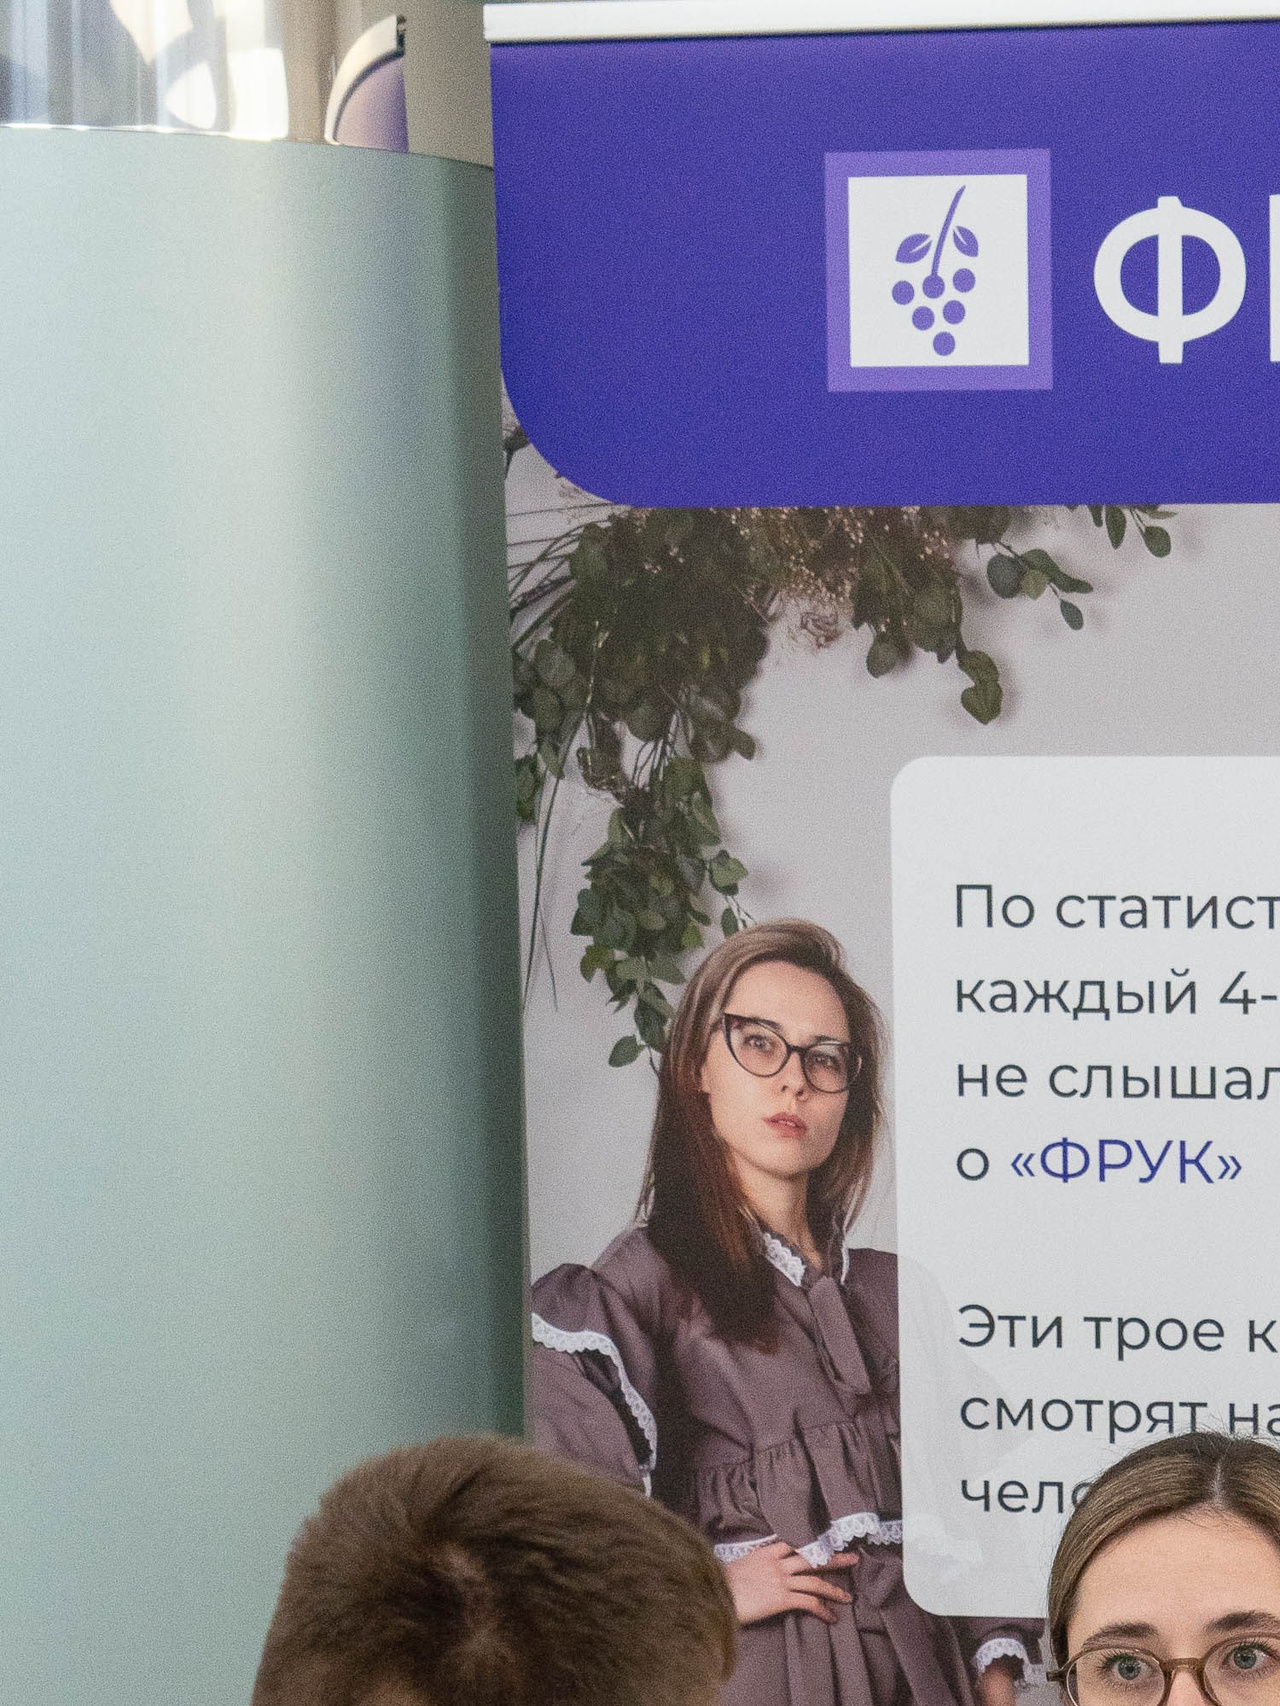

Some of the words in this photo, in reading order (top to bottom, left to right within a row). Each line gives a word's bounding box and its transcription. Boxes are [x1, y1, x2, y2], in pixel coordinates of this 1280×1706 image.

[955, 884, 1035, 929] По
[956, 968, 1197, 1021] каждый
[957, 1063, 1028, 1098] не
[956, 1147, 990, 1181] о
[1010, 1137, 1242, 1184] «ФРУК»
[958, 1303, 1064, 1349] Эти
[1083, 1316, 1225, 1361] трое
[959, 1396, 1208, 1443] смотрят
